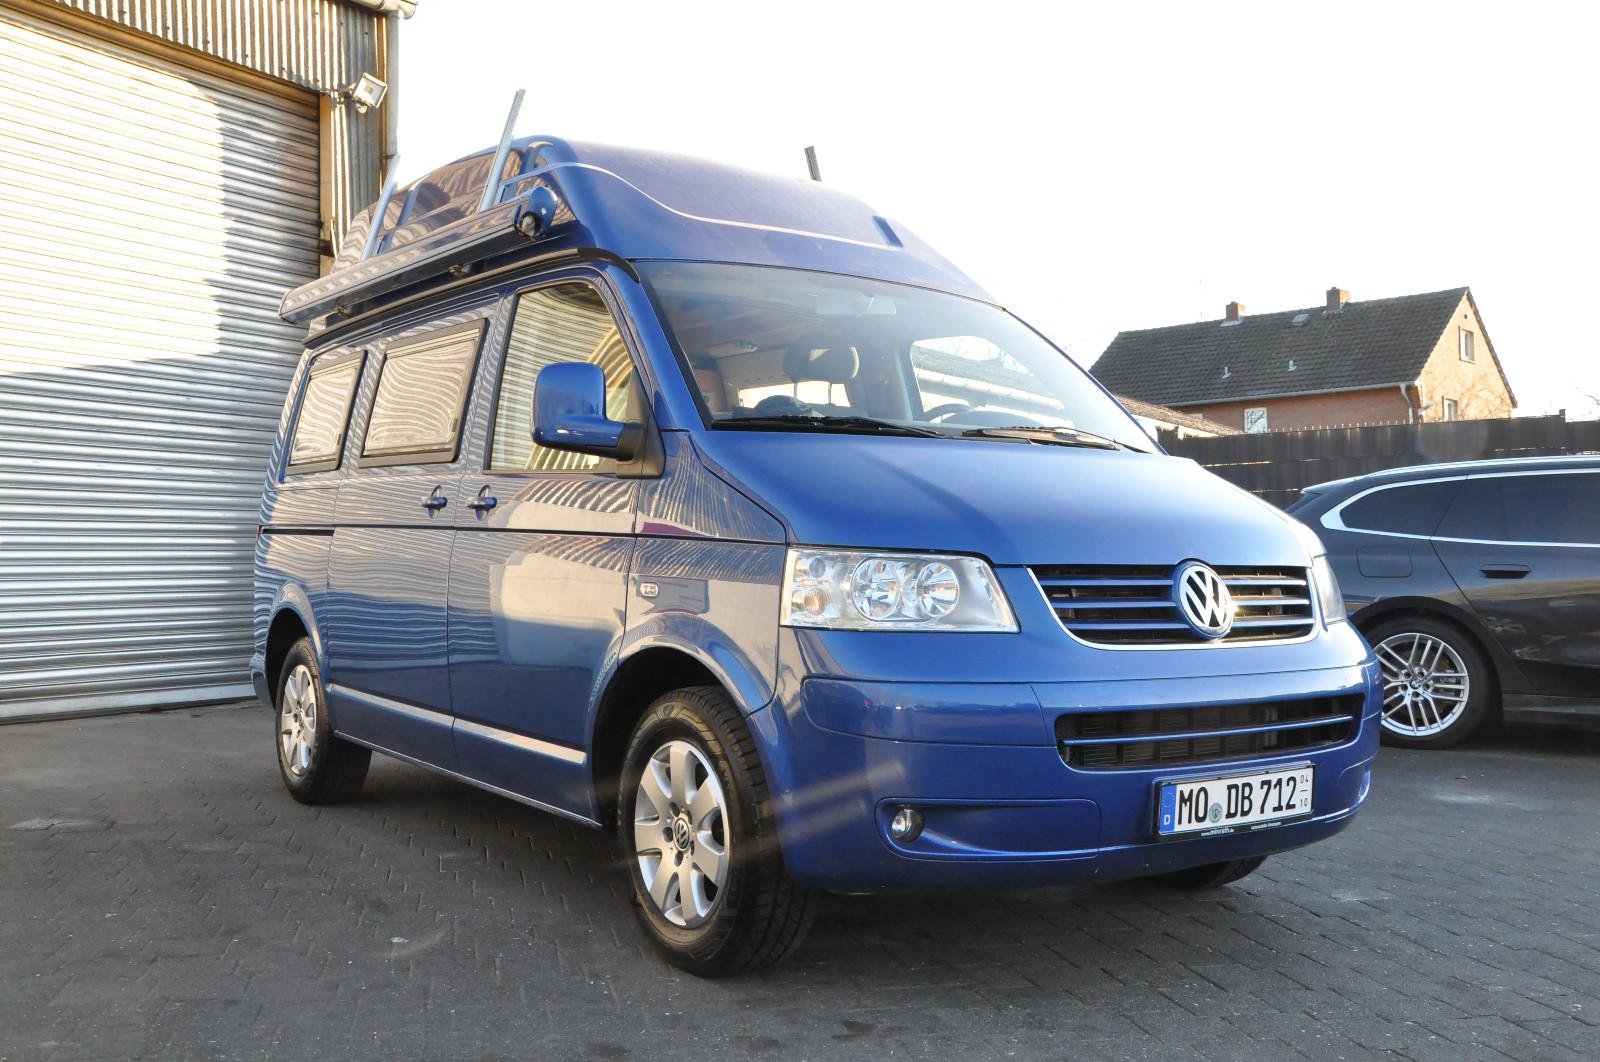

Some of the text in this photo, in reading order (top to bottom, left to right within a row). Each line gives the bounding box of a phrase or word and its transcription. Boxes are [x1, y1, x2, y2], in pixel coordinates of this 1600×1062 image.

[1179, 565, 1231, 634] VW
[1300, 774, 1309, 784] 04
[1178, 776, 1297, 825] MO DB 712
[1300, 797, 1308, 808] 10
[1163, 814, 1171, 825] D
